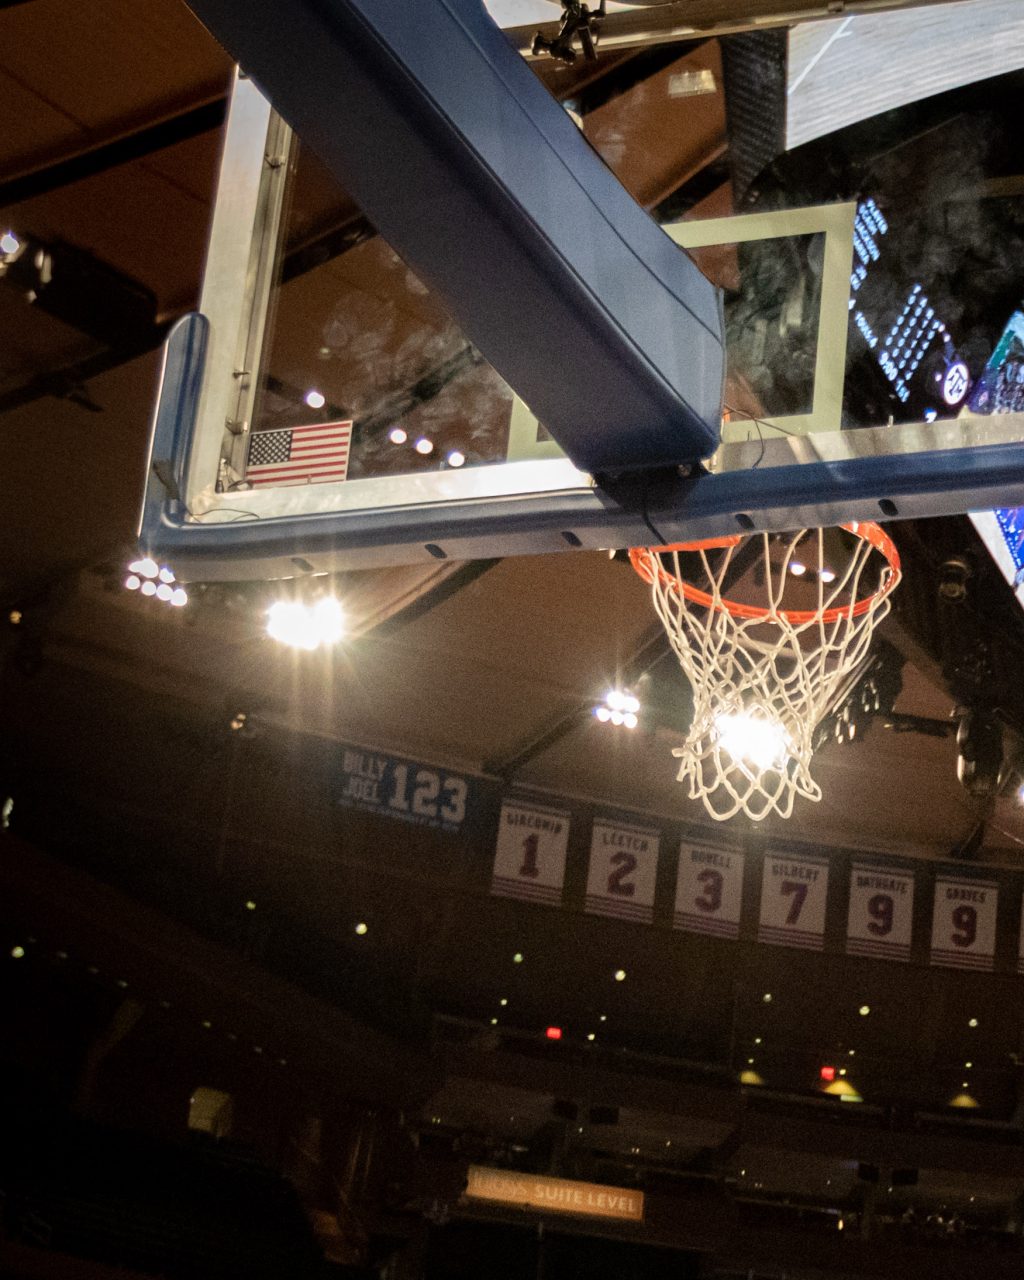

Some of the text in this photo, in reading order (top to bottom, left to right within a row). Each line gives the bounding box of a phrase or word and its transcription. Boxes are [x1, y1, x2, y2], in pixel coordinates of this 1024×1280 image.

[388, 763, 468, 824] 123
[518, 833, 540, 878] 1
[606, 851, 637, 896] 2
[694, 869, 723, 913] 3
[780, 881, 808, 925] 7
[867, 894, 894, 936] 9
[951, 905, 977, 948] 9
[535, 1184, 584, 1204] SUITE
[588, 1192, 635, 1213] LEVEL
